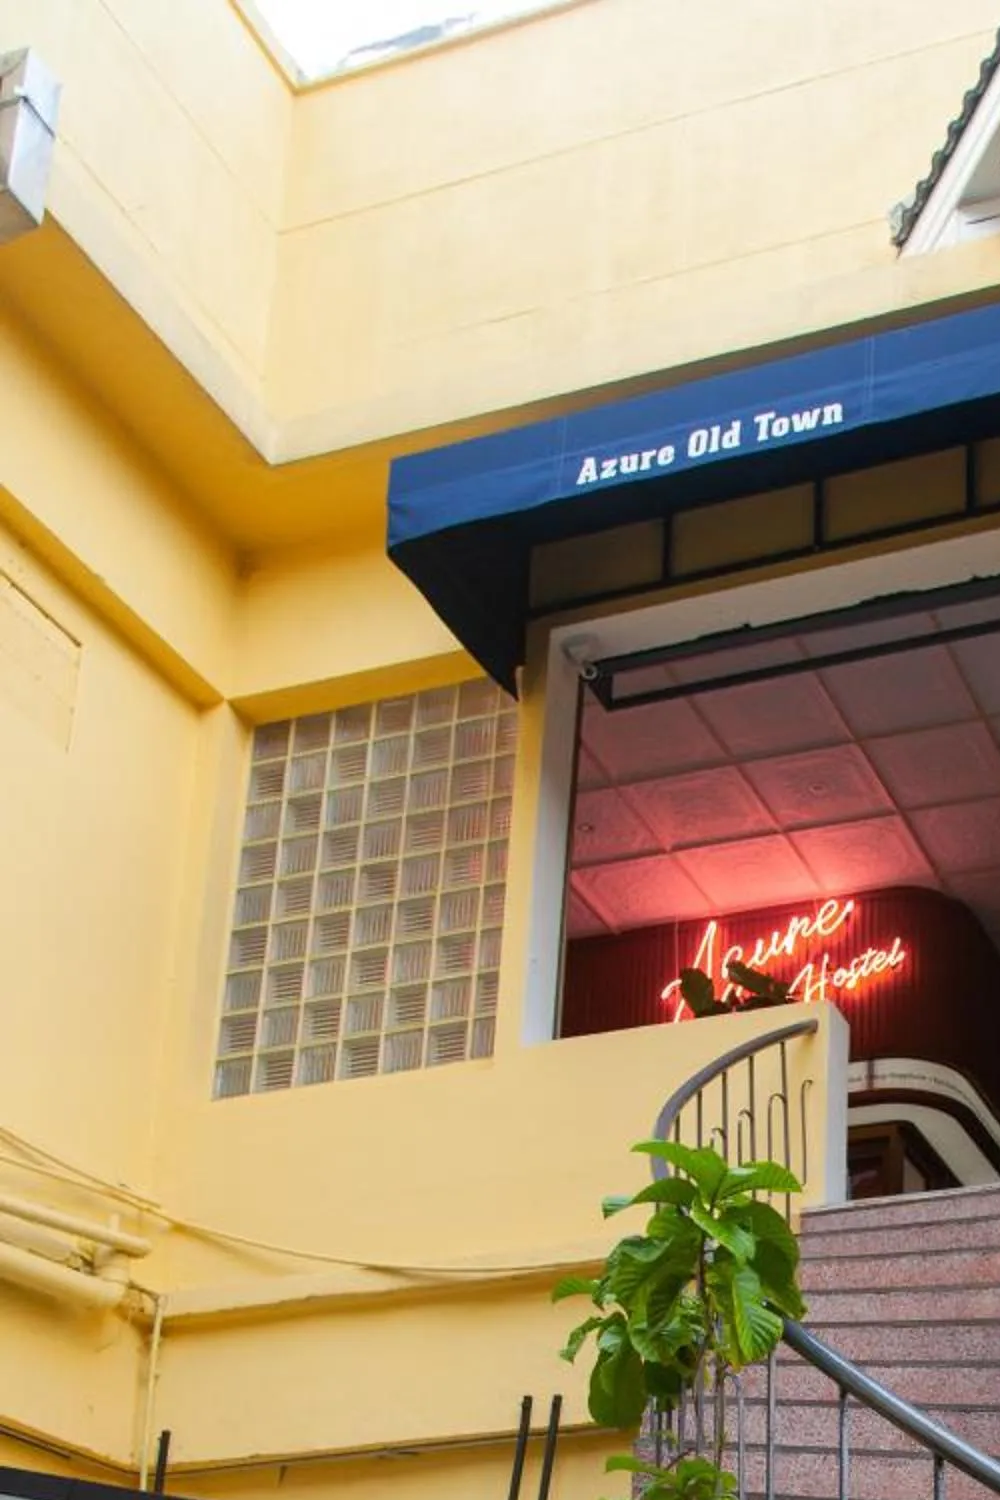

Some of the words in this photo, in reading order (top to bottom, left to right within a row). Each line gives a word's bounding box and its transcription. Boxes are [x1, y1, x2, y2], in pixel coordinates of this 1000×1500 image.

[576, 443, 676, 485] Azure
[687, 419, 741, 458] Old
[753, 402, 844, 441] Town
[787, 937, 905, 1004] Hostel
